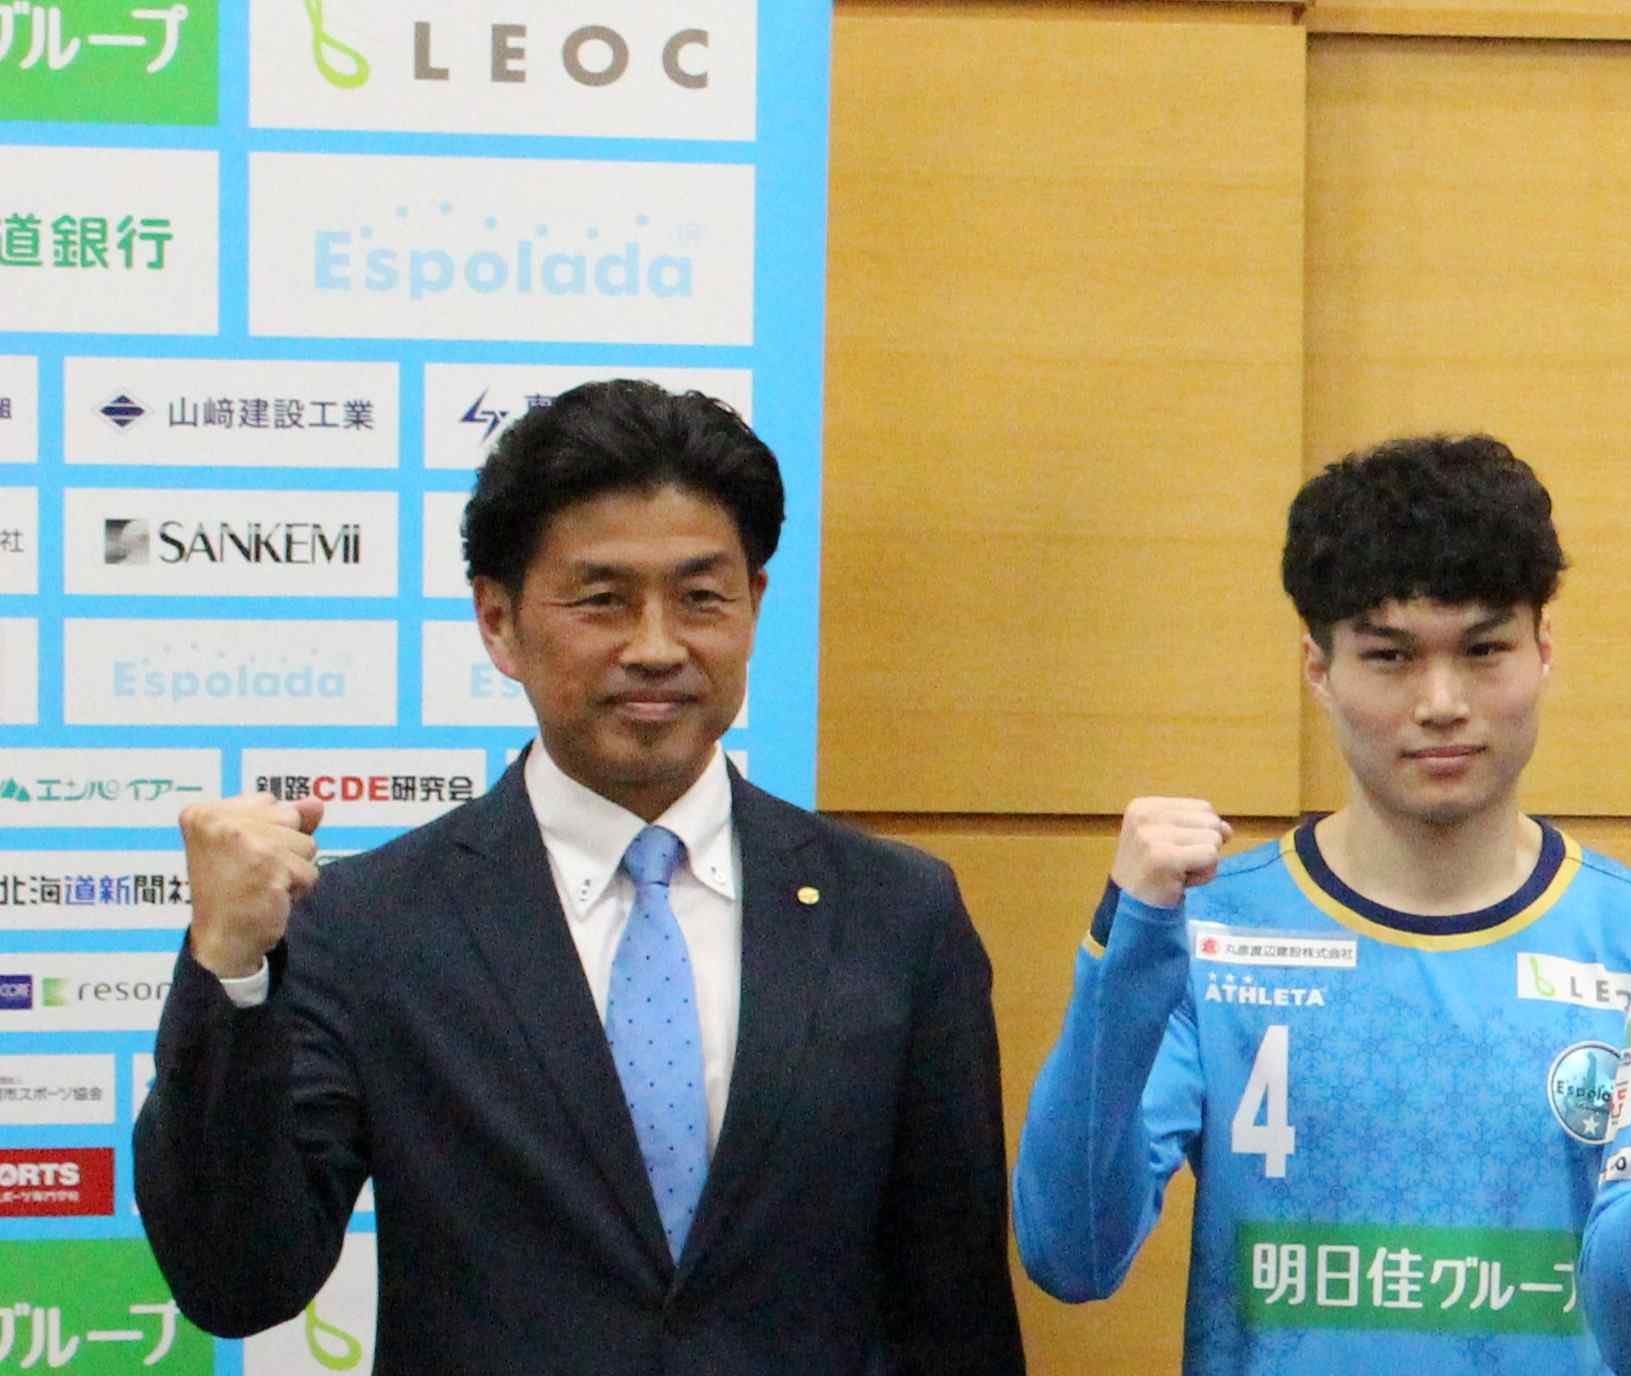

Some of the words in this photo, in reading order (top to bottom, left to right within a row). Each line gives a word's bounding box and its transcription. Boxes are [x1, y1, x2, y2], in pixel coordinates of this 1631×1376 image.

[413, 21, 710, 89] LEOC
[313, 229, 694, 301] Espolada
[113, 660, 346, 703] Espolada
[1204, 982, 1326, 1007] ATHLETA
[1232, 1024, 1296, 1178] 4
